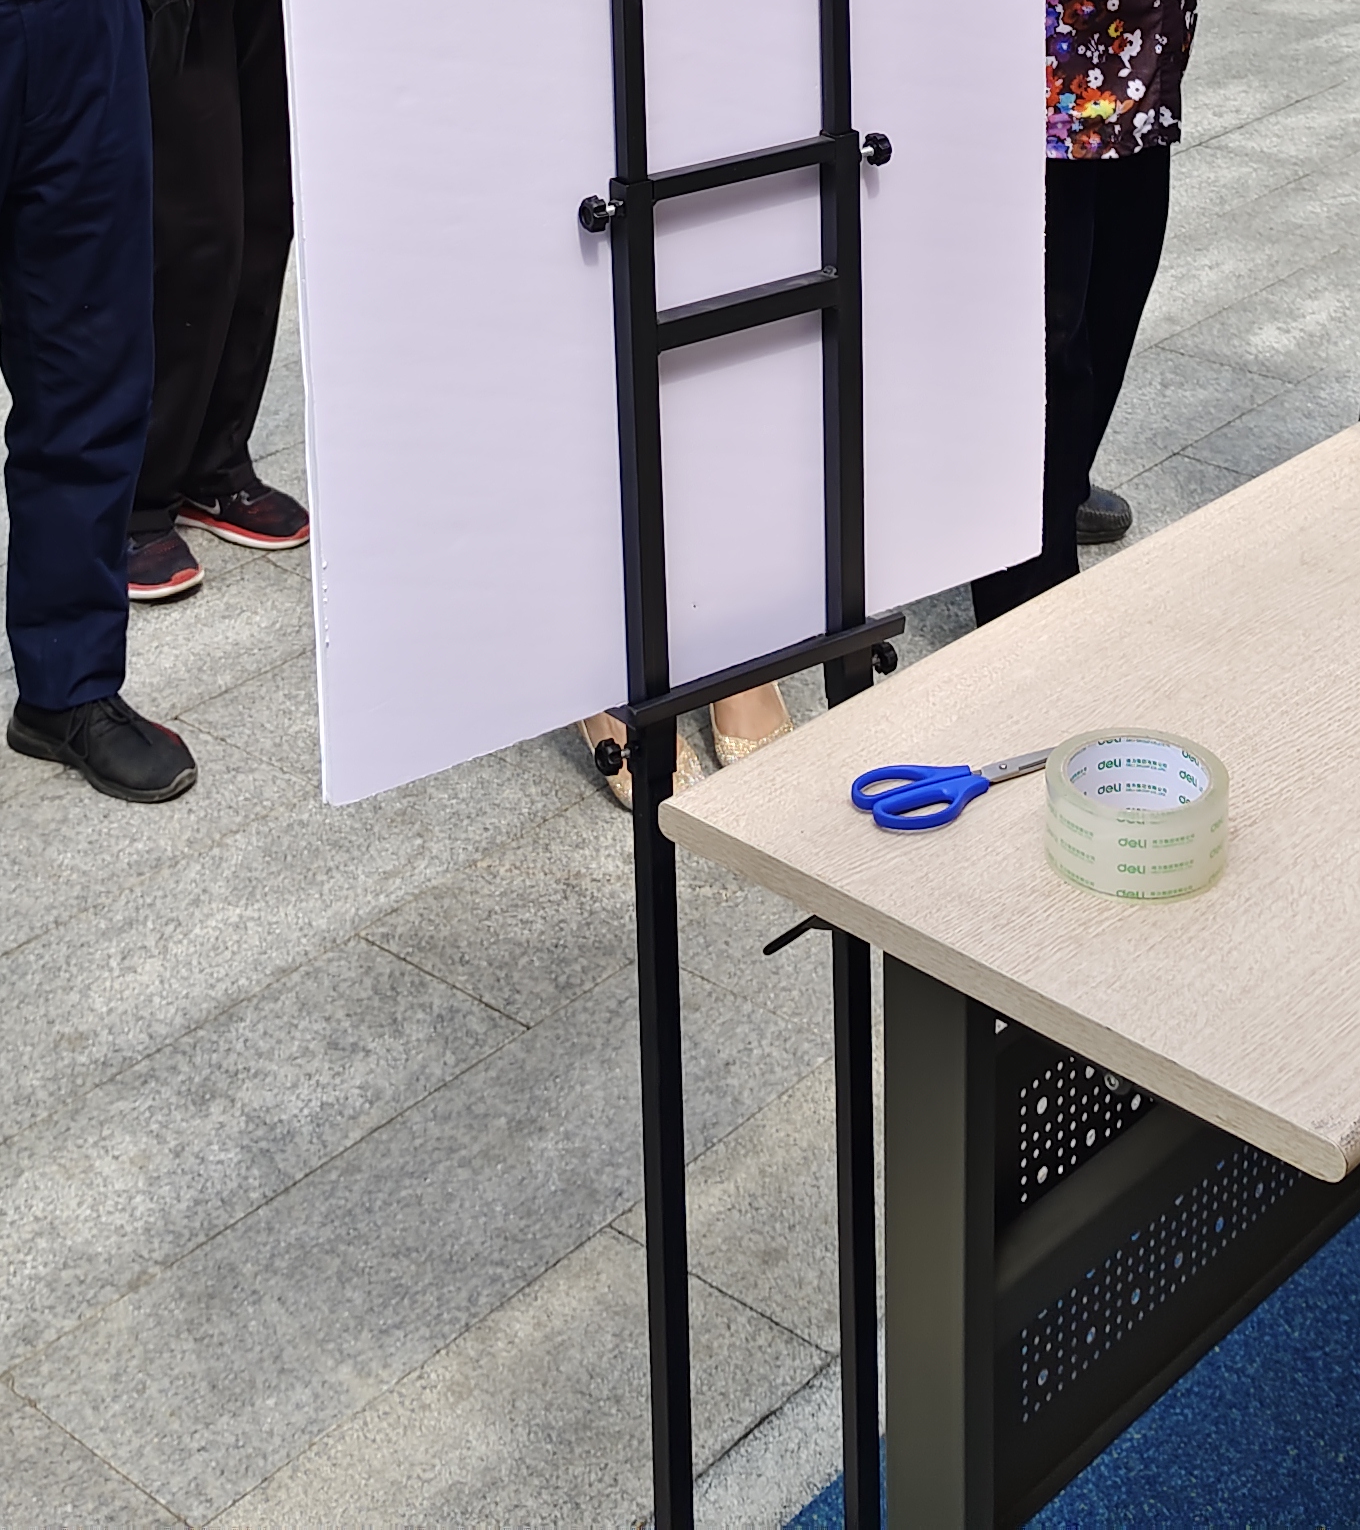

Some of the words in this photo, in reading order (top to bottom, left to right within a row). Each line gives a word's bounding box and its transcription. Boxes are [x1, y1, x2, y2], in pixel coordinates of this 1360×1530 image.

[1097, 758, 1122, 771] deli
[1097, 783, 1122, 795] deli
[1117, 838, 1147, 849] deli
[1116, 864, 1146, 875] deli
